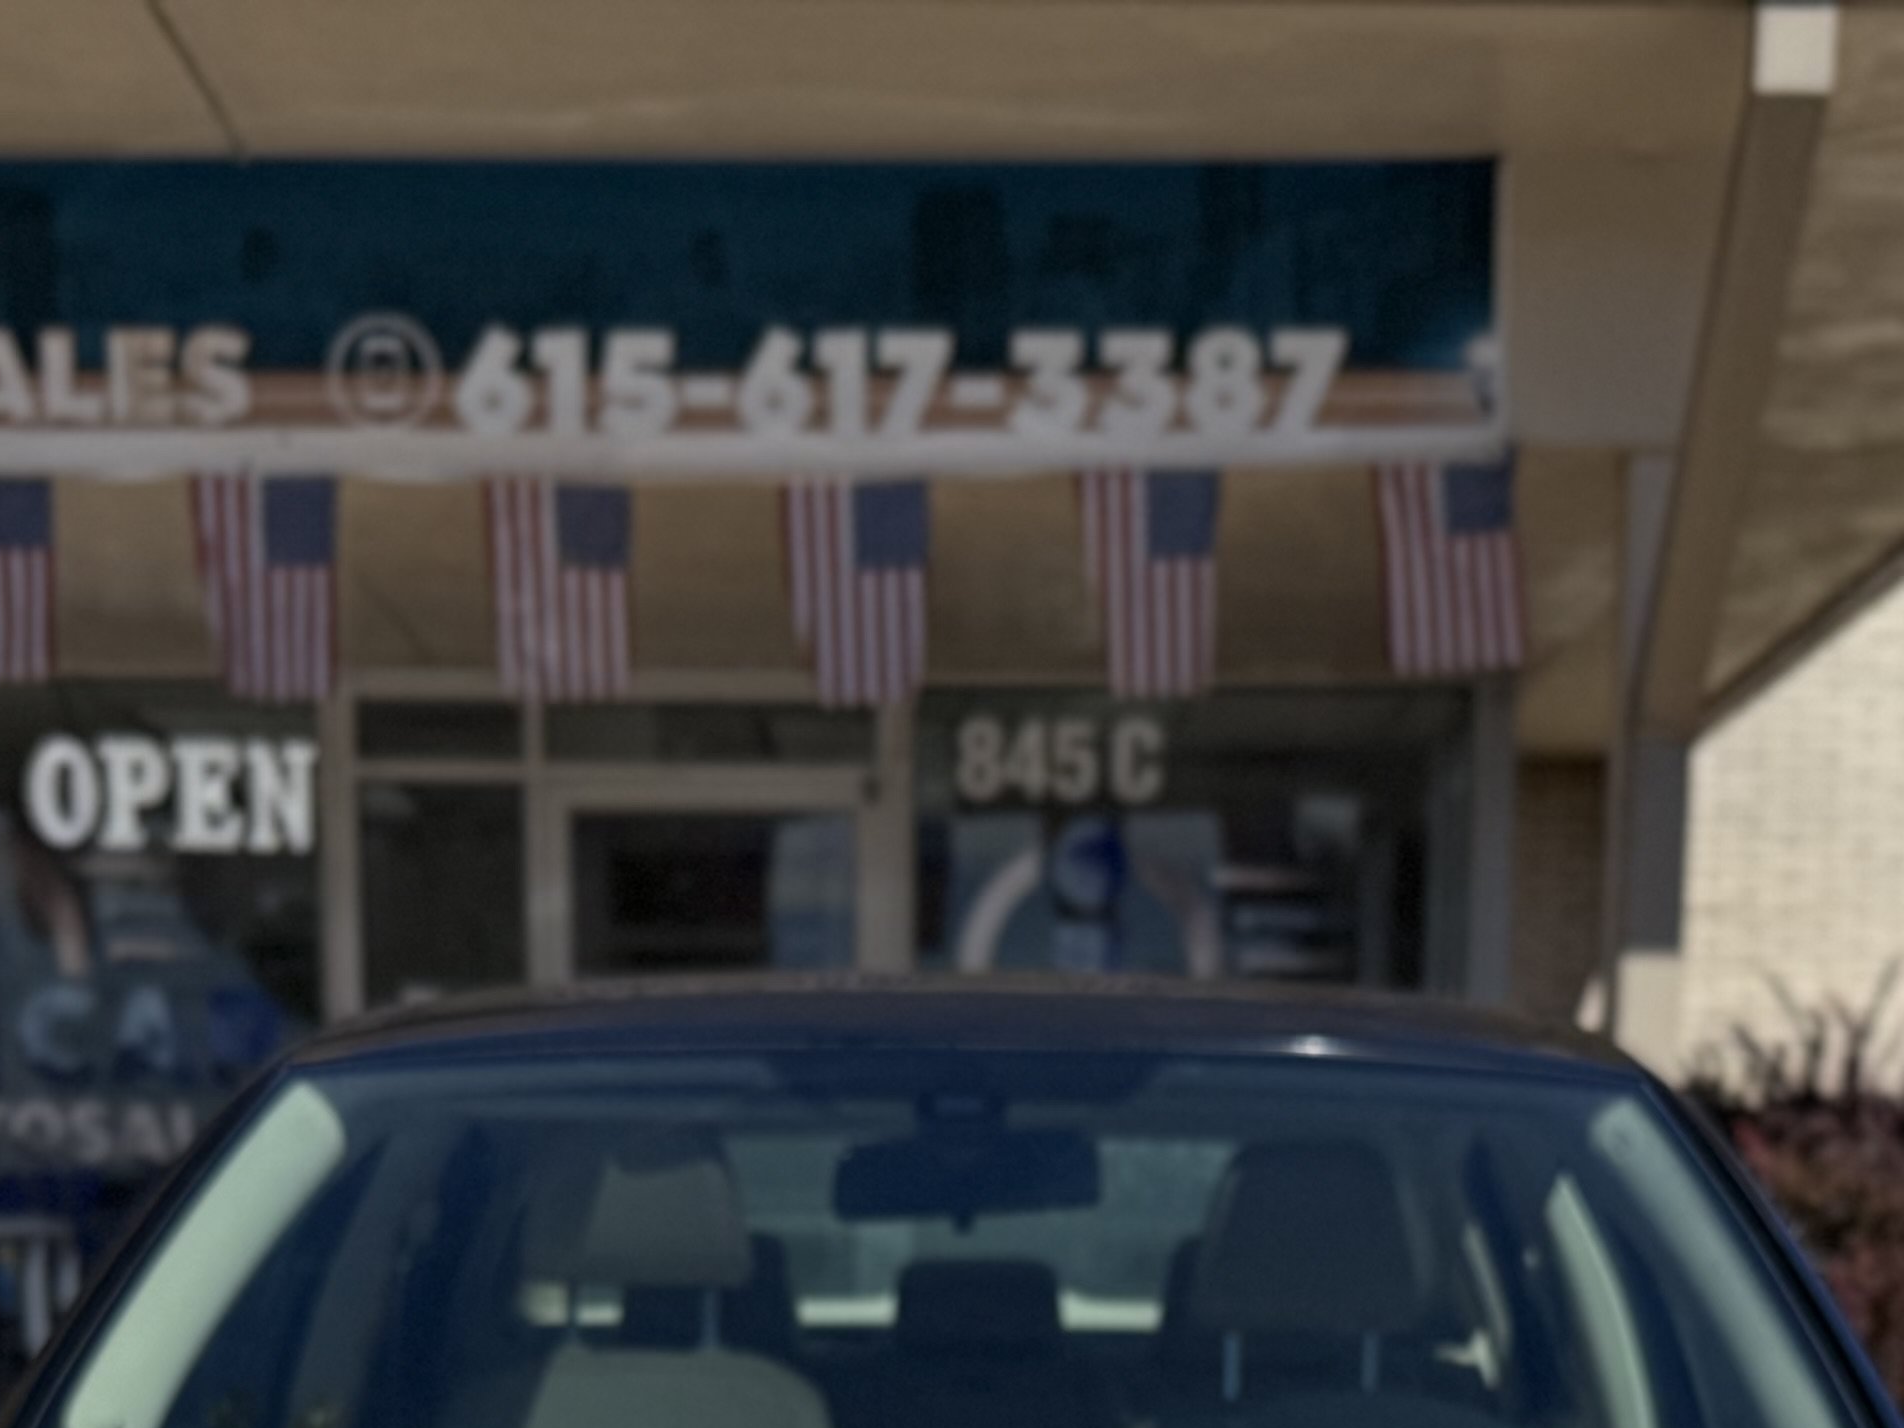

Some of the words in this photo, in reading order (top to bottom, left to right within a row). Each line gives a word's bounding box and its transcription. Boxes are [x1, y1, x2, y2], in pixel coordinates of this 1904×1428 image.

[456, 325, 1348, 440] 615-617-3387
[26, 735, 317, 853] OPEN
[955, 716, 1096, 804] 845
[1110, 717, 1166, 803] C
